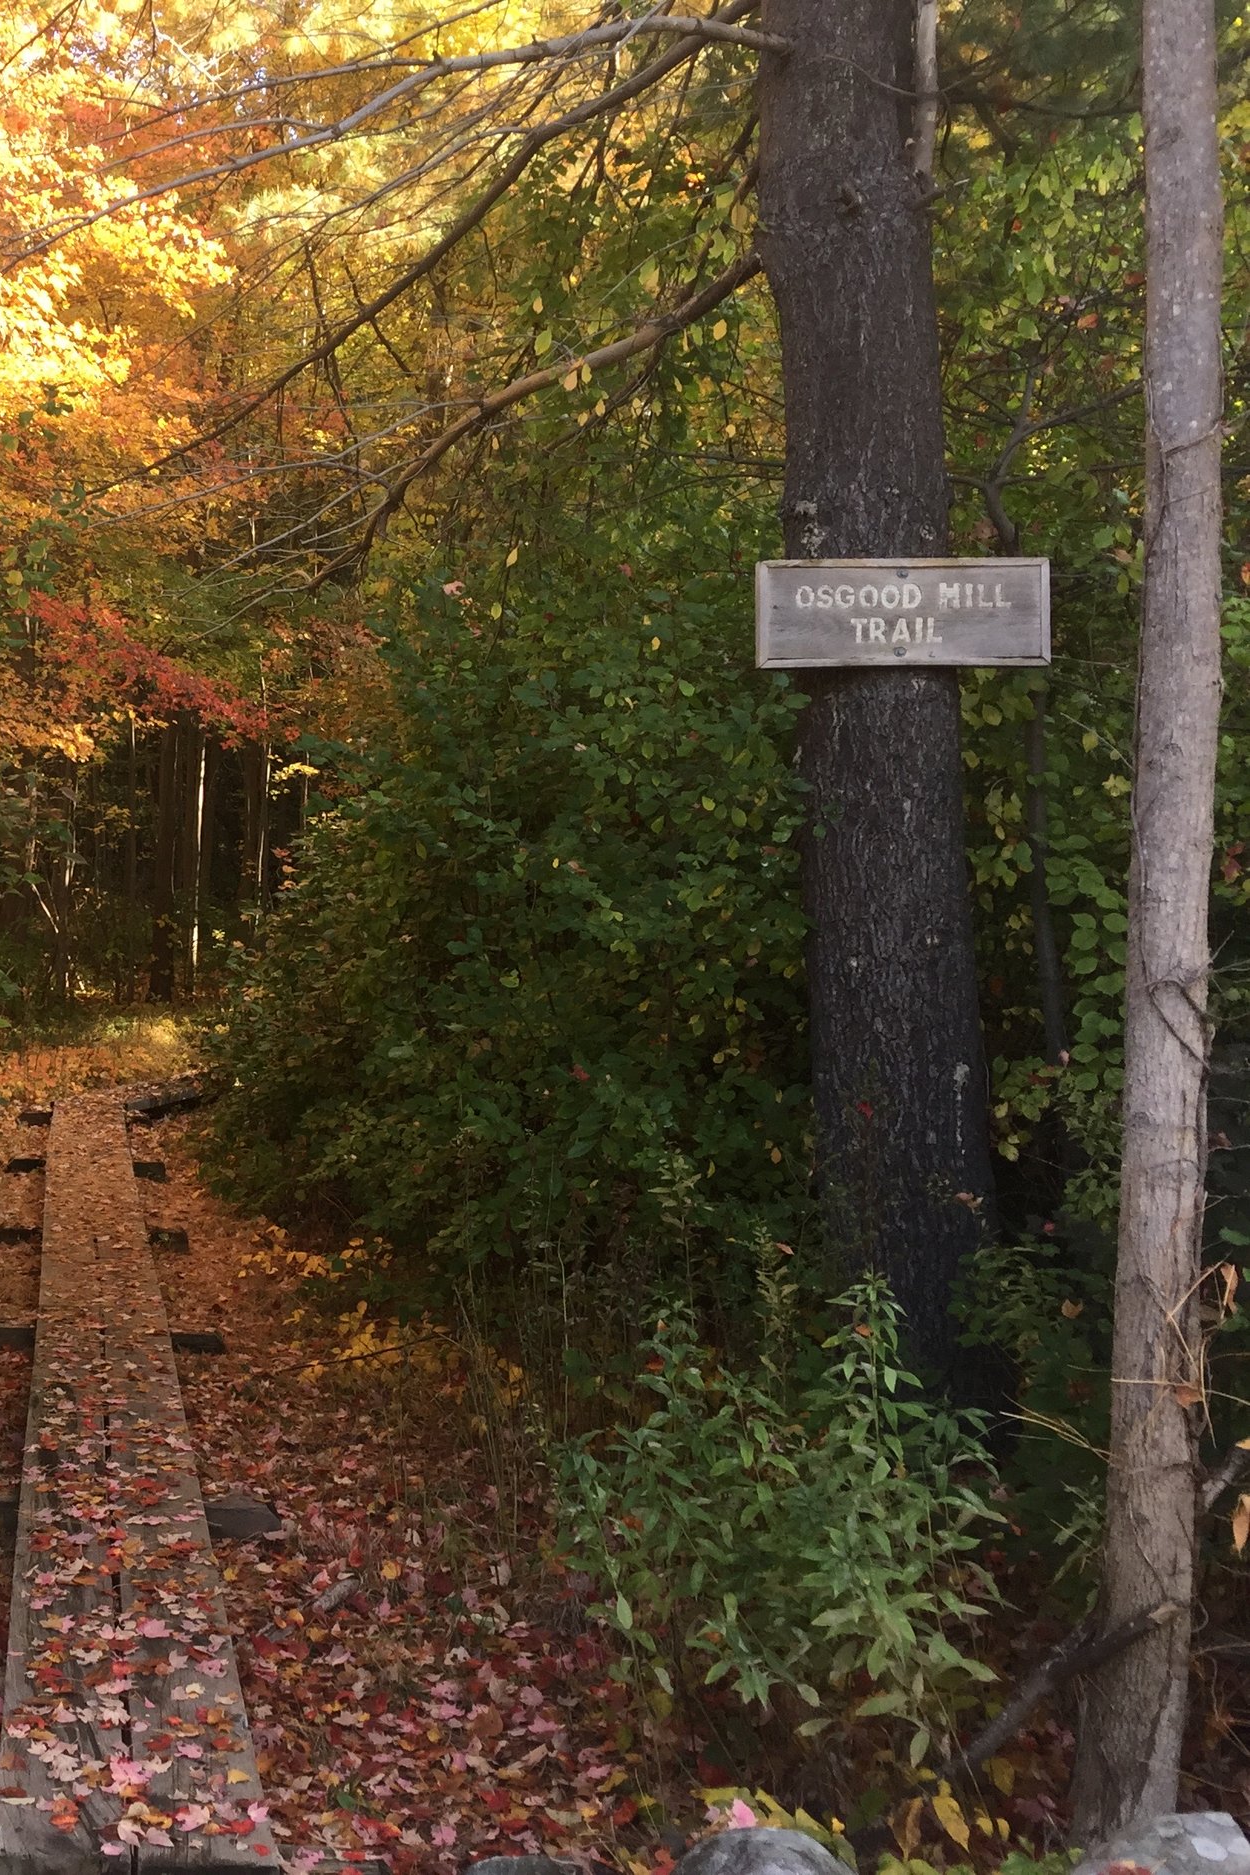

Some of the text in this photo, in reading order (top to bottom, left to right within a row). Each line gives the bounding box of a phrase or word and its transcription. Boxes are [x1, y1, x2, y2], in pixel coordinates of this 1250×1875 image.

[795, 582, 1012, 609] OSGOOD HILL
[850, 617, 943, 644] TRAIL
